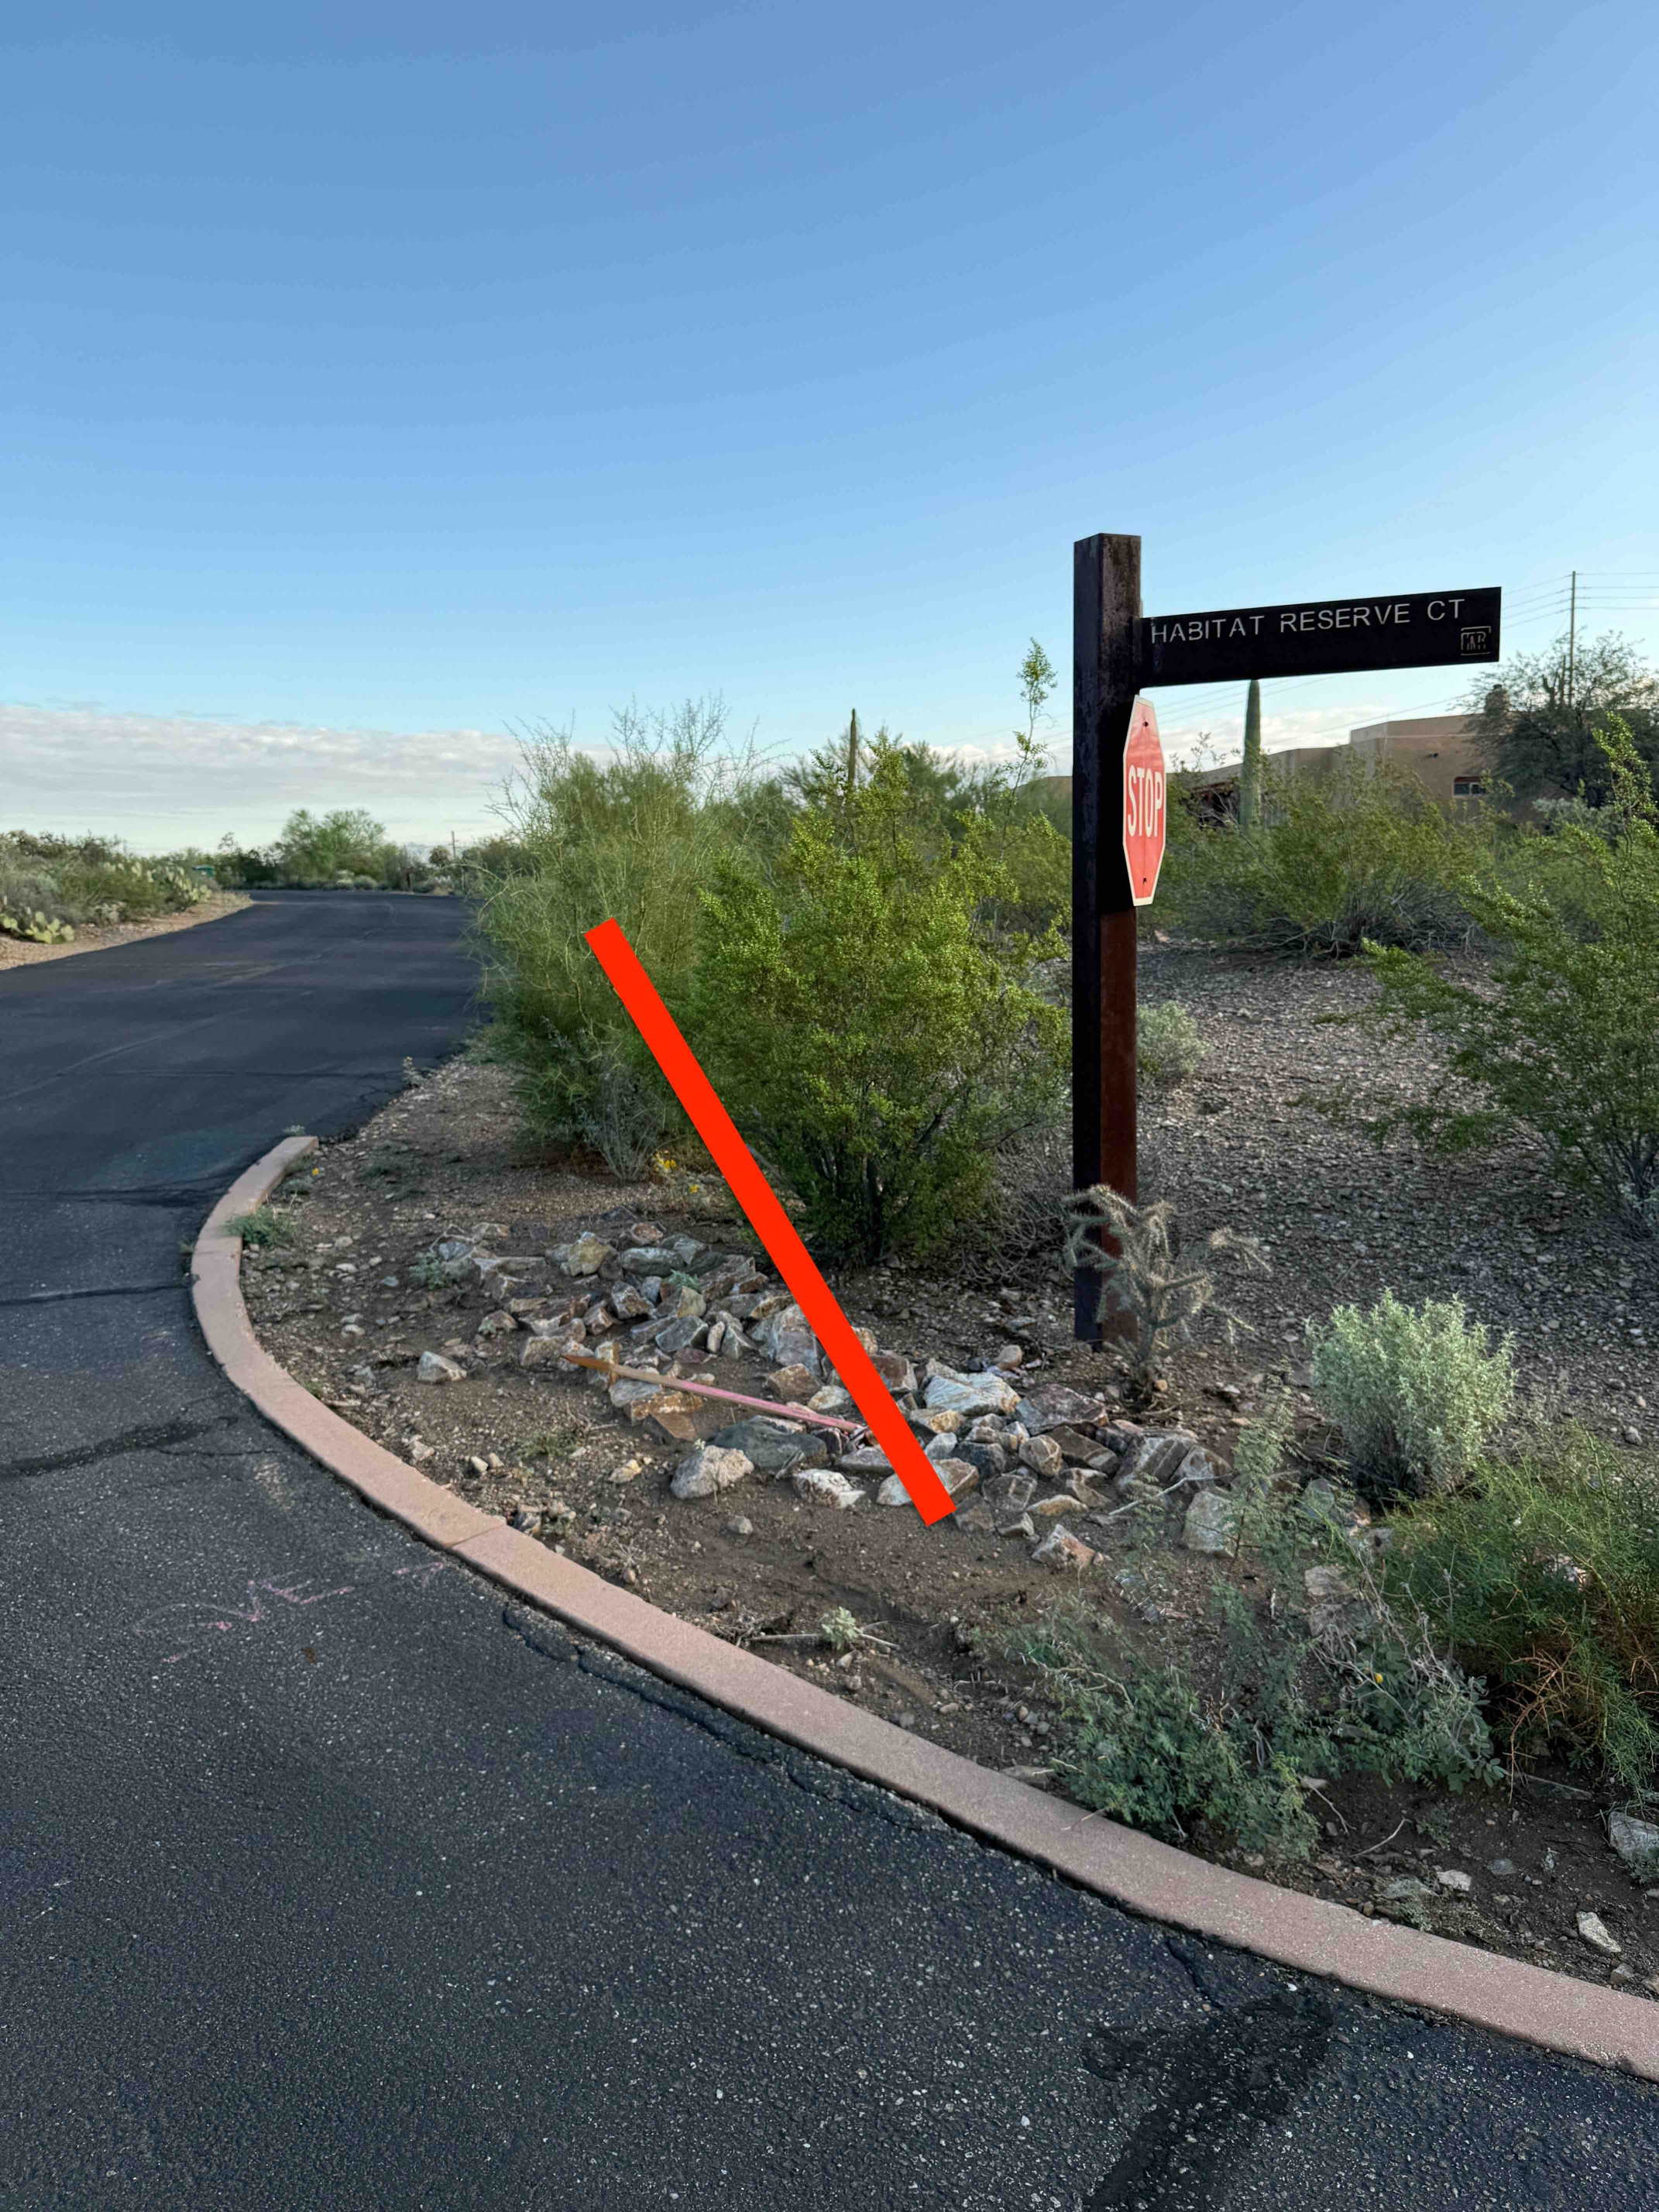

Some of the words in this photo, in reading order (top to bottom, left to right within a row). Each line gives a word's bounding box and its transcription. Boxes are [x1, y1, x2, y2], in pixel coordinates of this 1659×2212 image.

[1151, 616, 1264, 644] HABITAT
[1280, 604, 1410, 633] RESERVE
[1427, 599, 1465, 620] CT
[1128, 764, 1163, 837] STOP
